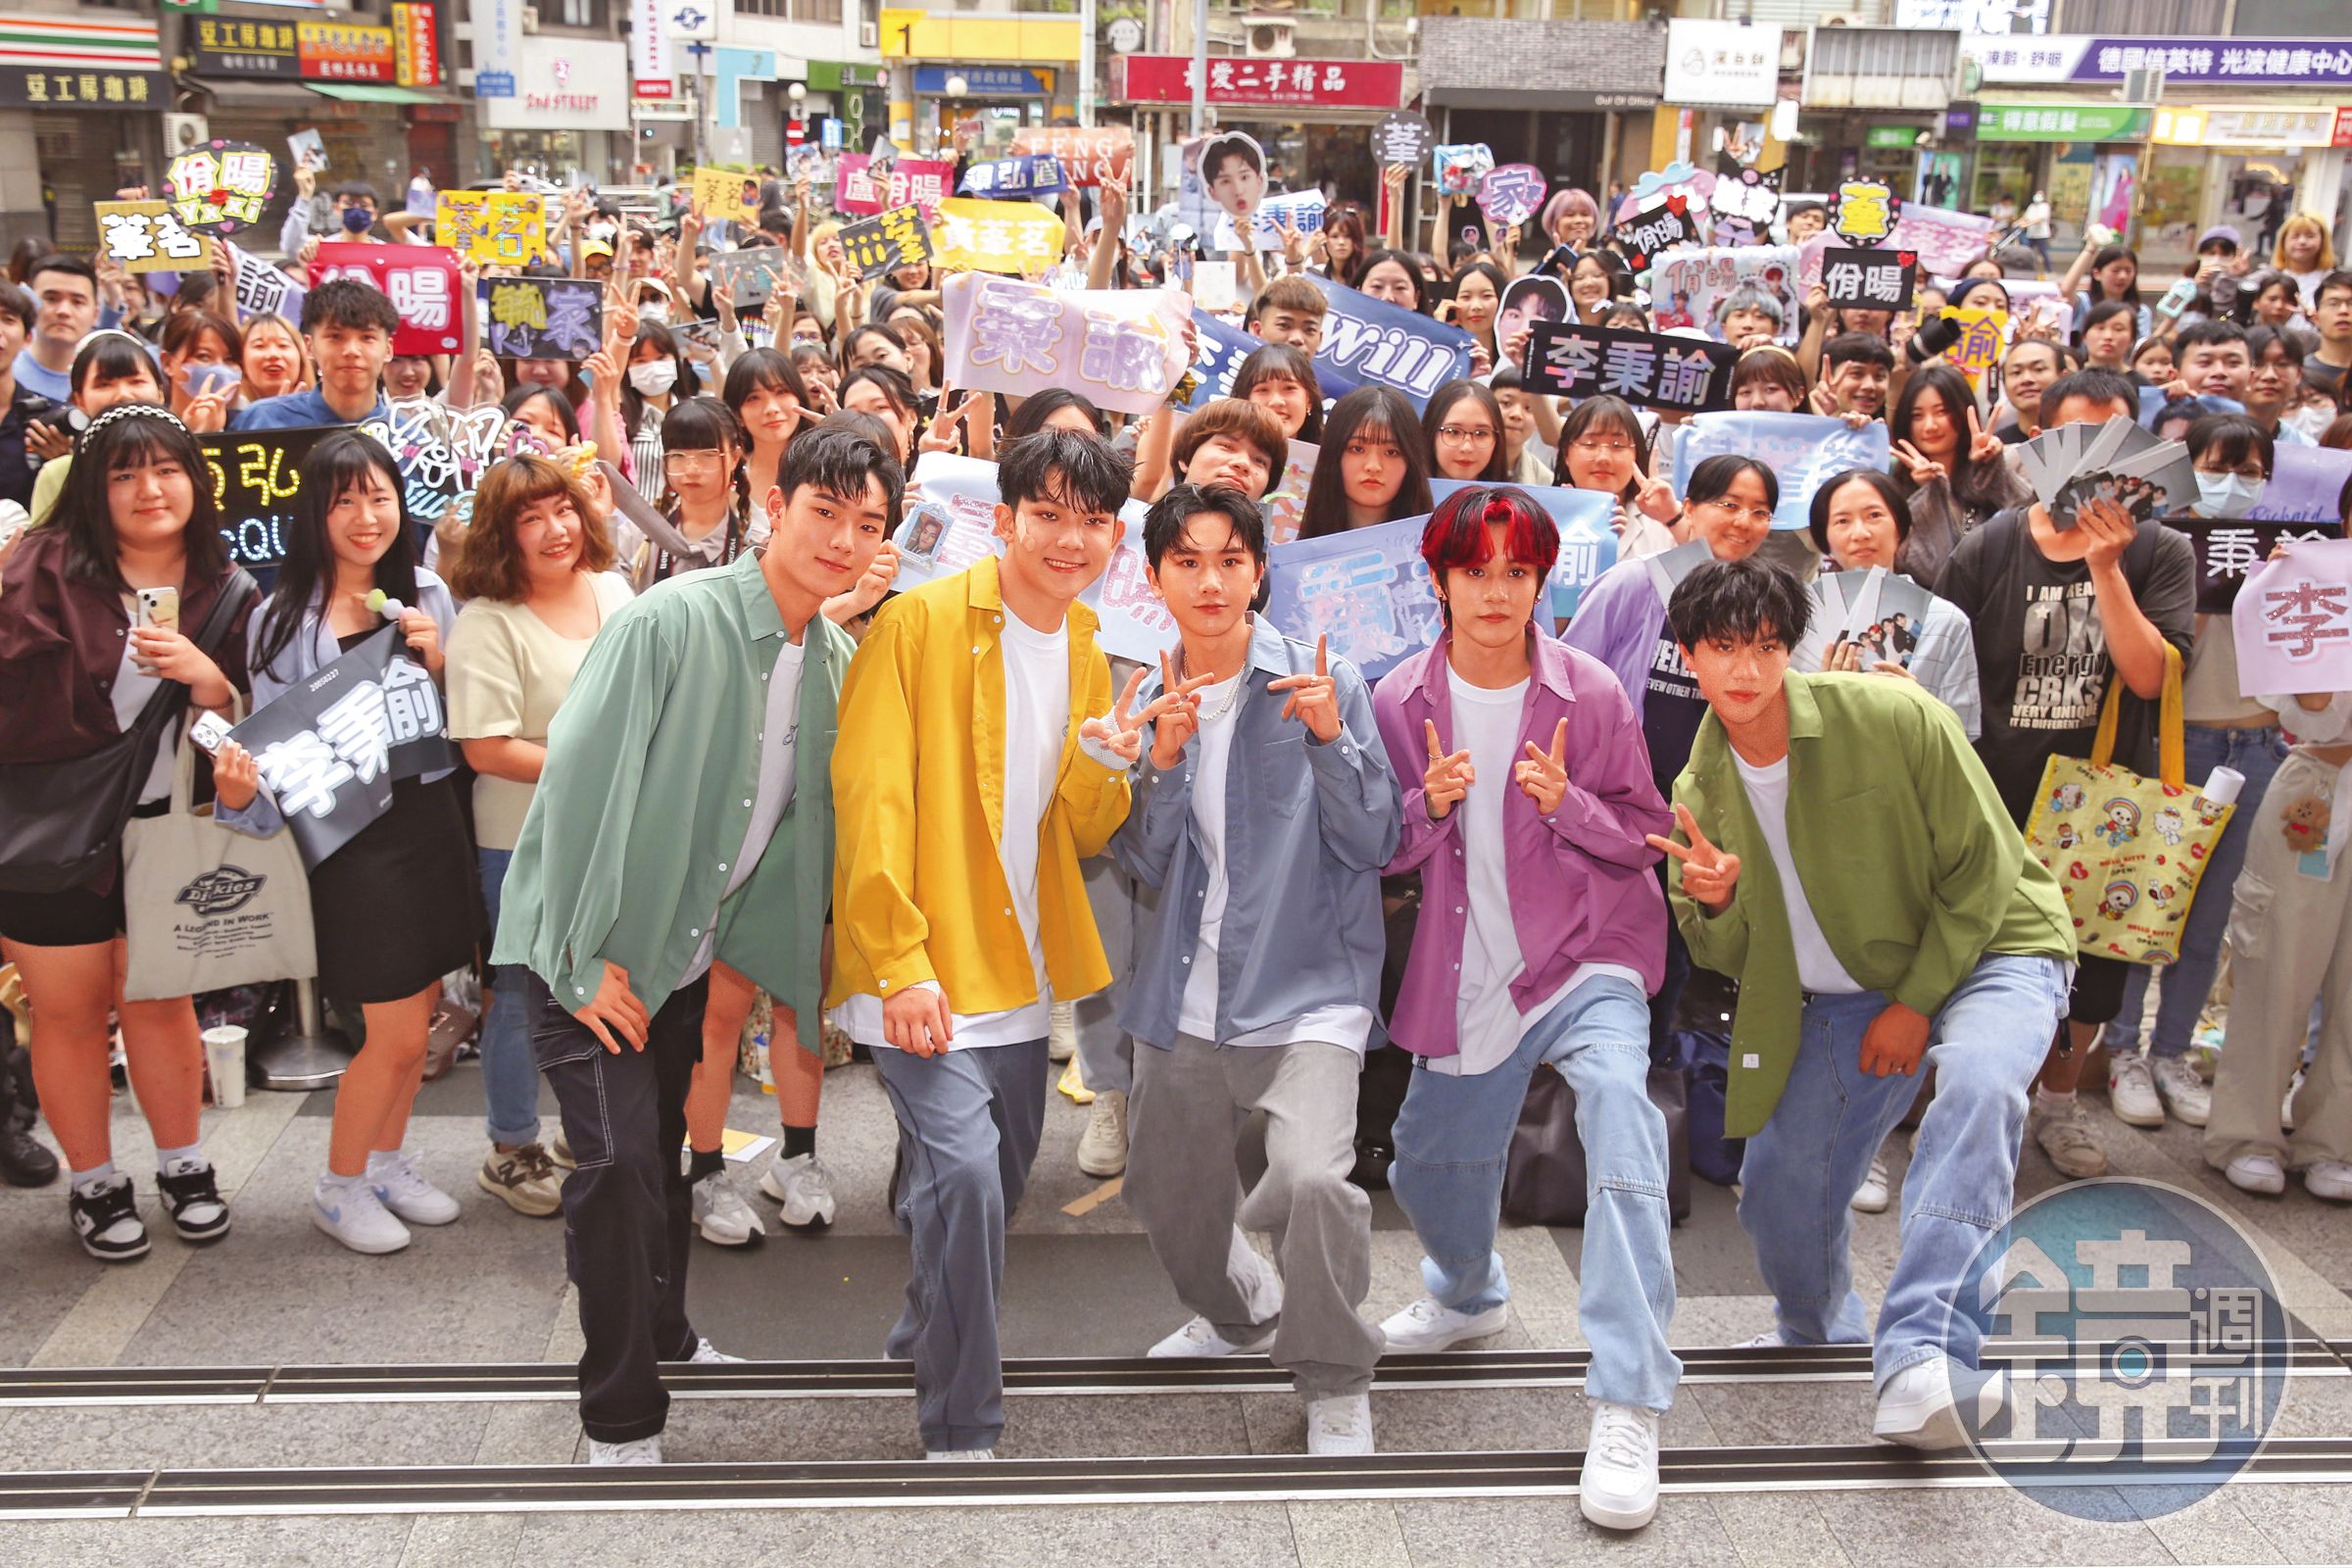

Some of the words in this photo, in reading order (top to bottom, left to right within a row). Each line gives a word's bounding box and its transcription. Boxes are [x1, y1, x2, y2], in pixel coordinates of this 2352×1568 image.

[898, 24, 910, 55] 1
[553, 94, 599, 111] STREET
[1029, 135, 1114, 159] FENG
[1826, 263, 1903, 303] 佾暘
[1544, 334, 1717, 406] 李秉諭
[2026, 585, 2034, 602] I
[2038, 585, 2064, 602] AM
[2265, 581, 2350, 658] 李
[2011, 704, 2050, 718] VERY
[237, 912, 270, 923] WORK
